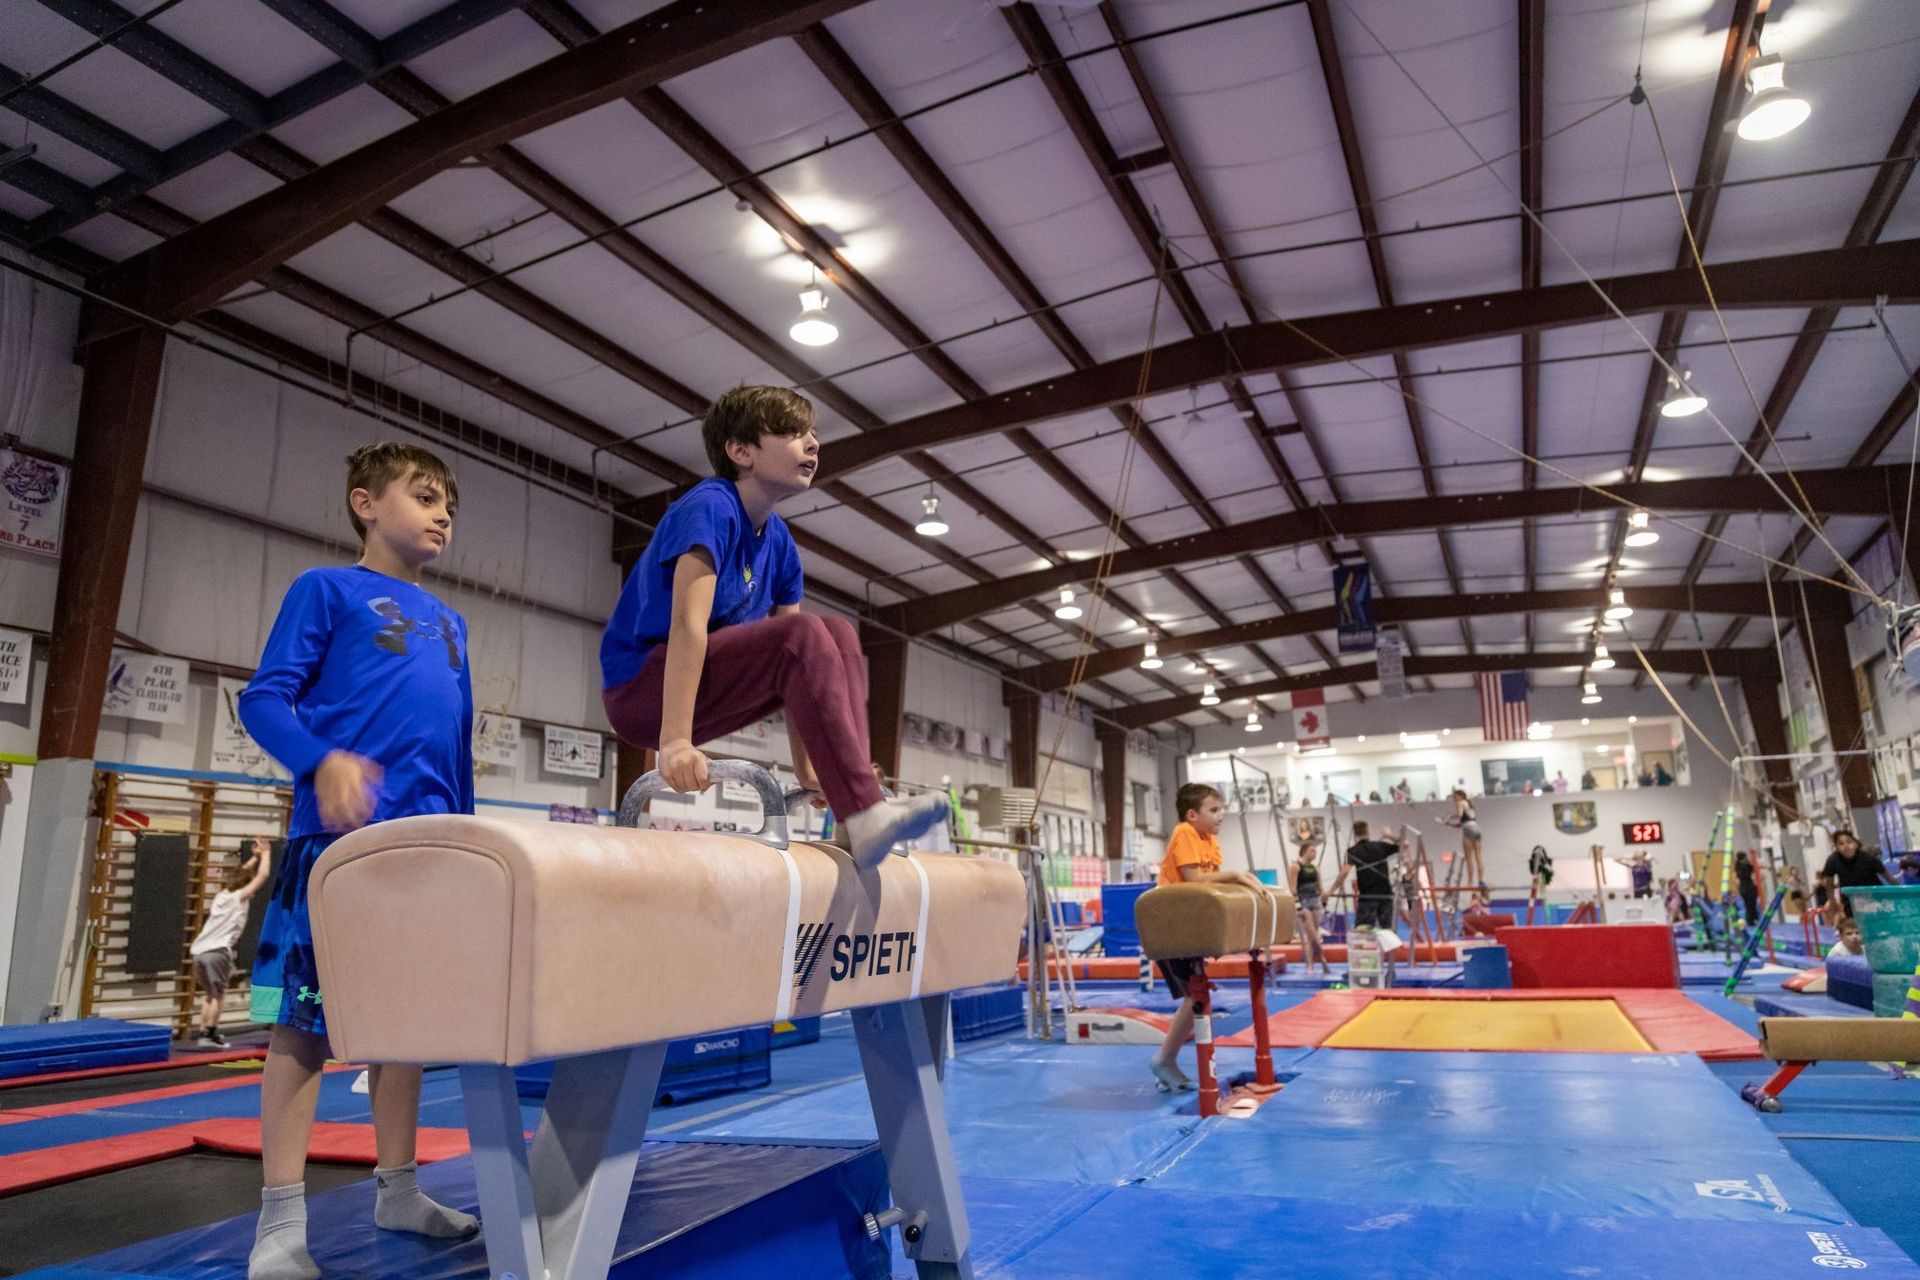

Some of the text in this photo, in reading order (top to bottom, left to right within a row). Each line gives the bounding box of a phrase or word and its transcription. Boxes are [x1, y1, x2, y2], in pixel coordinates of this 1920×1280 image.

[8, 501, 42, 517] LEVEL
[19, 520, 28, 531] 7
[17, 534, 57, 551] PLACE
[144, 676, 177, 689] PLACE
